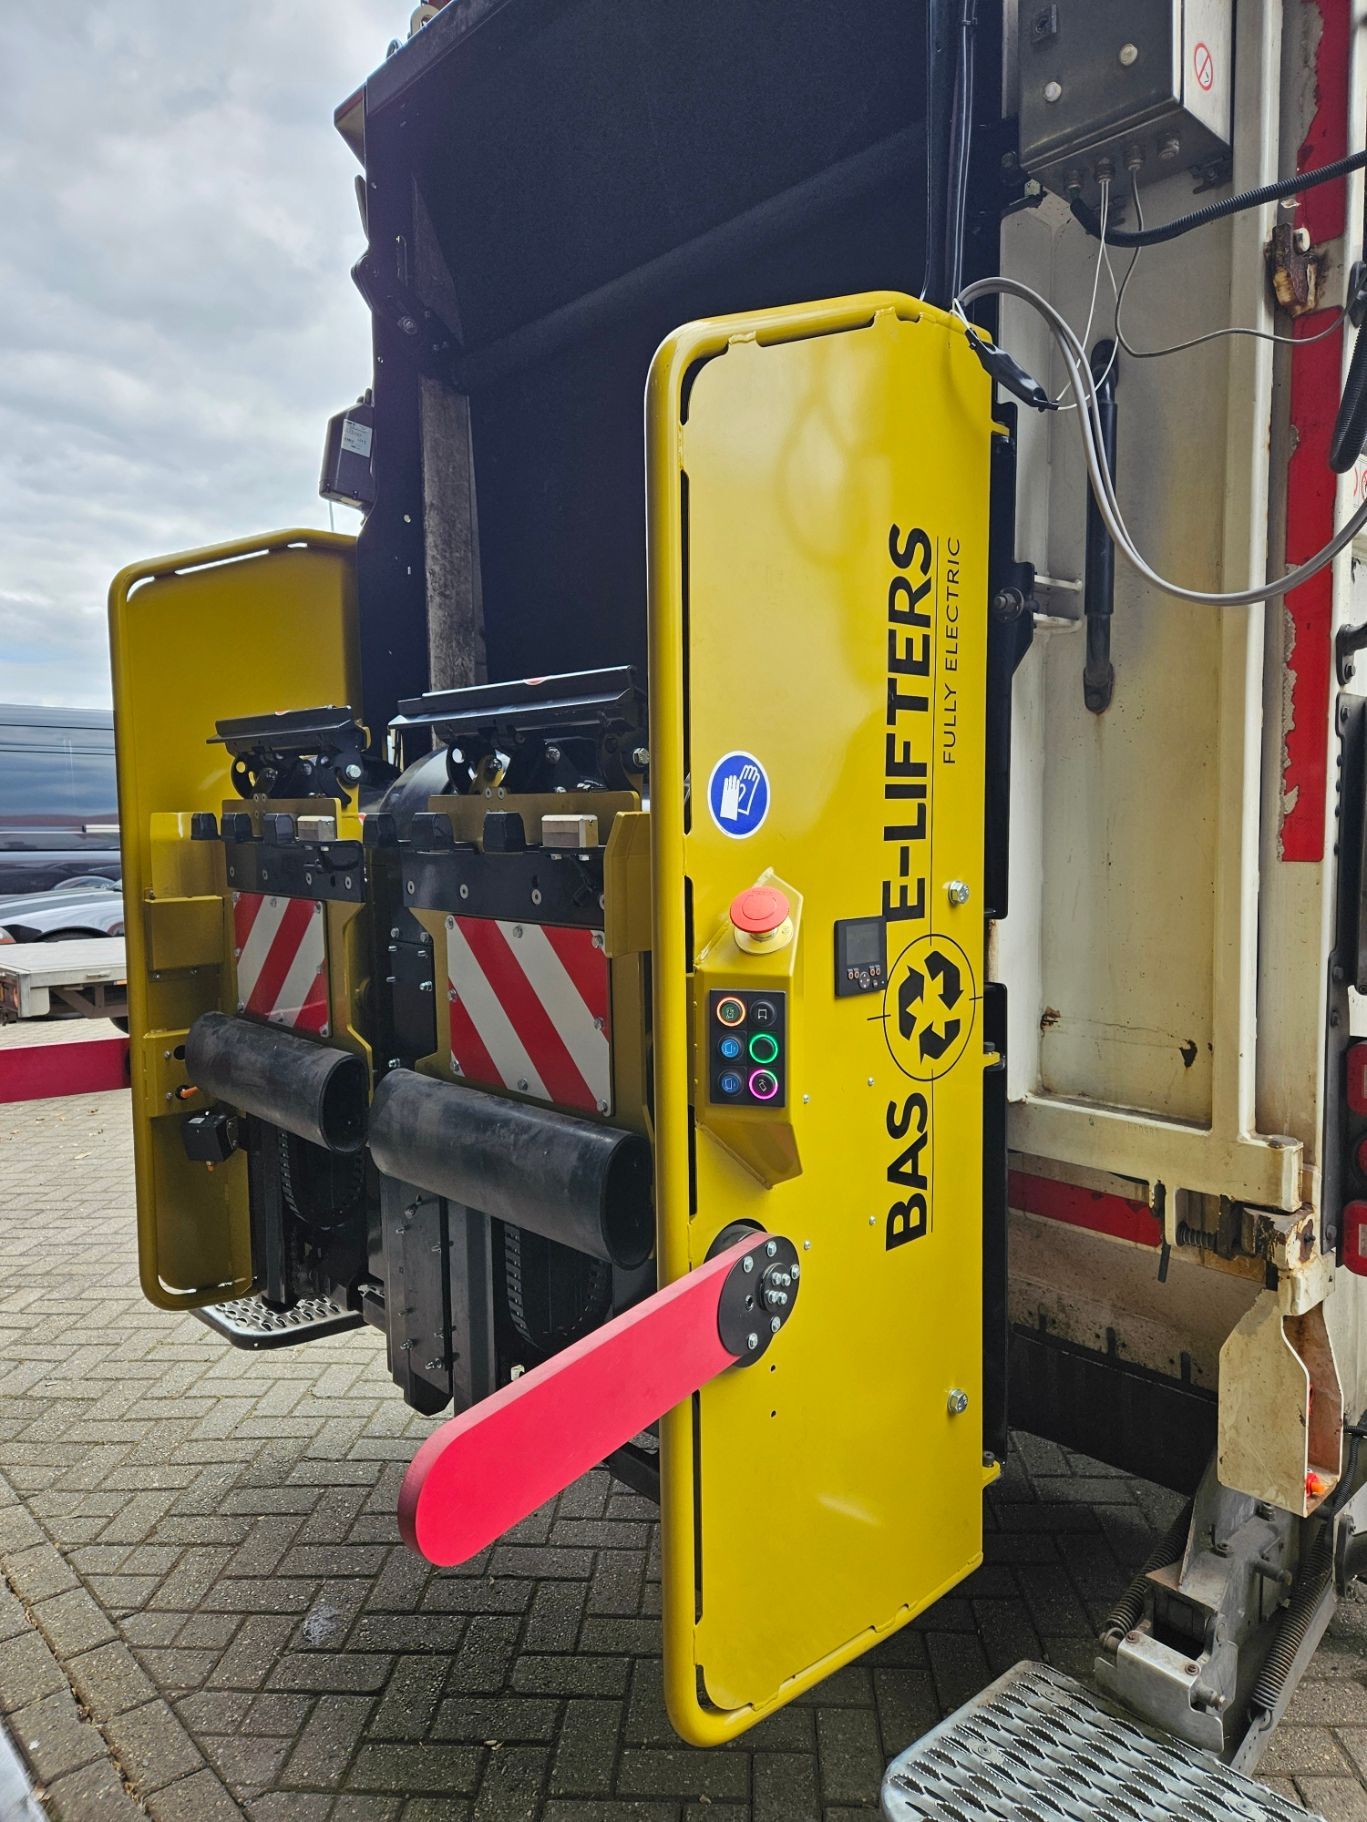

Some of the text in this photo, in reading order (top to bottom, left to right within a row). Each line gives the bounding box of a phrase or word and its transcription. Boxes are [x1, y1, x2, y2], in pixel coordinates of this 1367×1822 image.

[881, 523, 932, 1252] BAS E-LIFTERS
[943, 536, 961, 765] FULLY ELECTRIC
